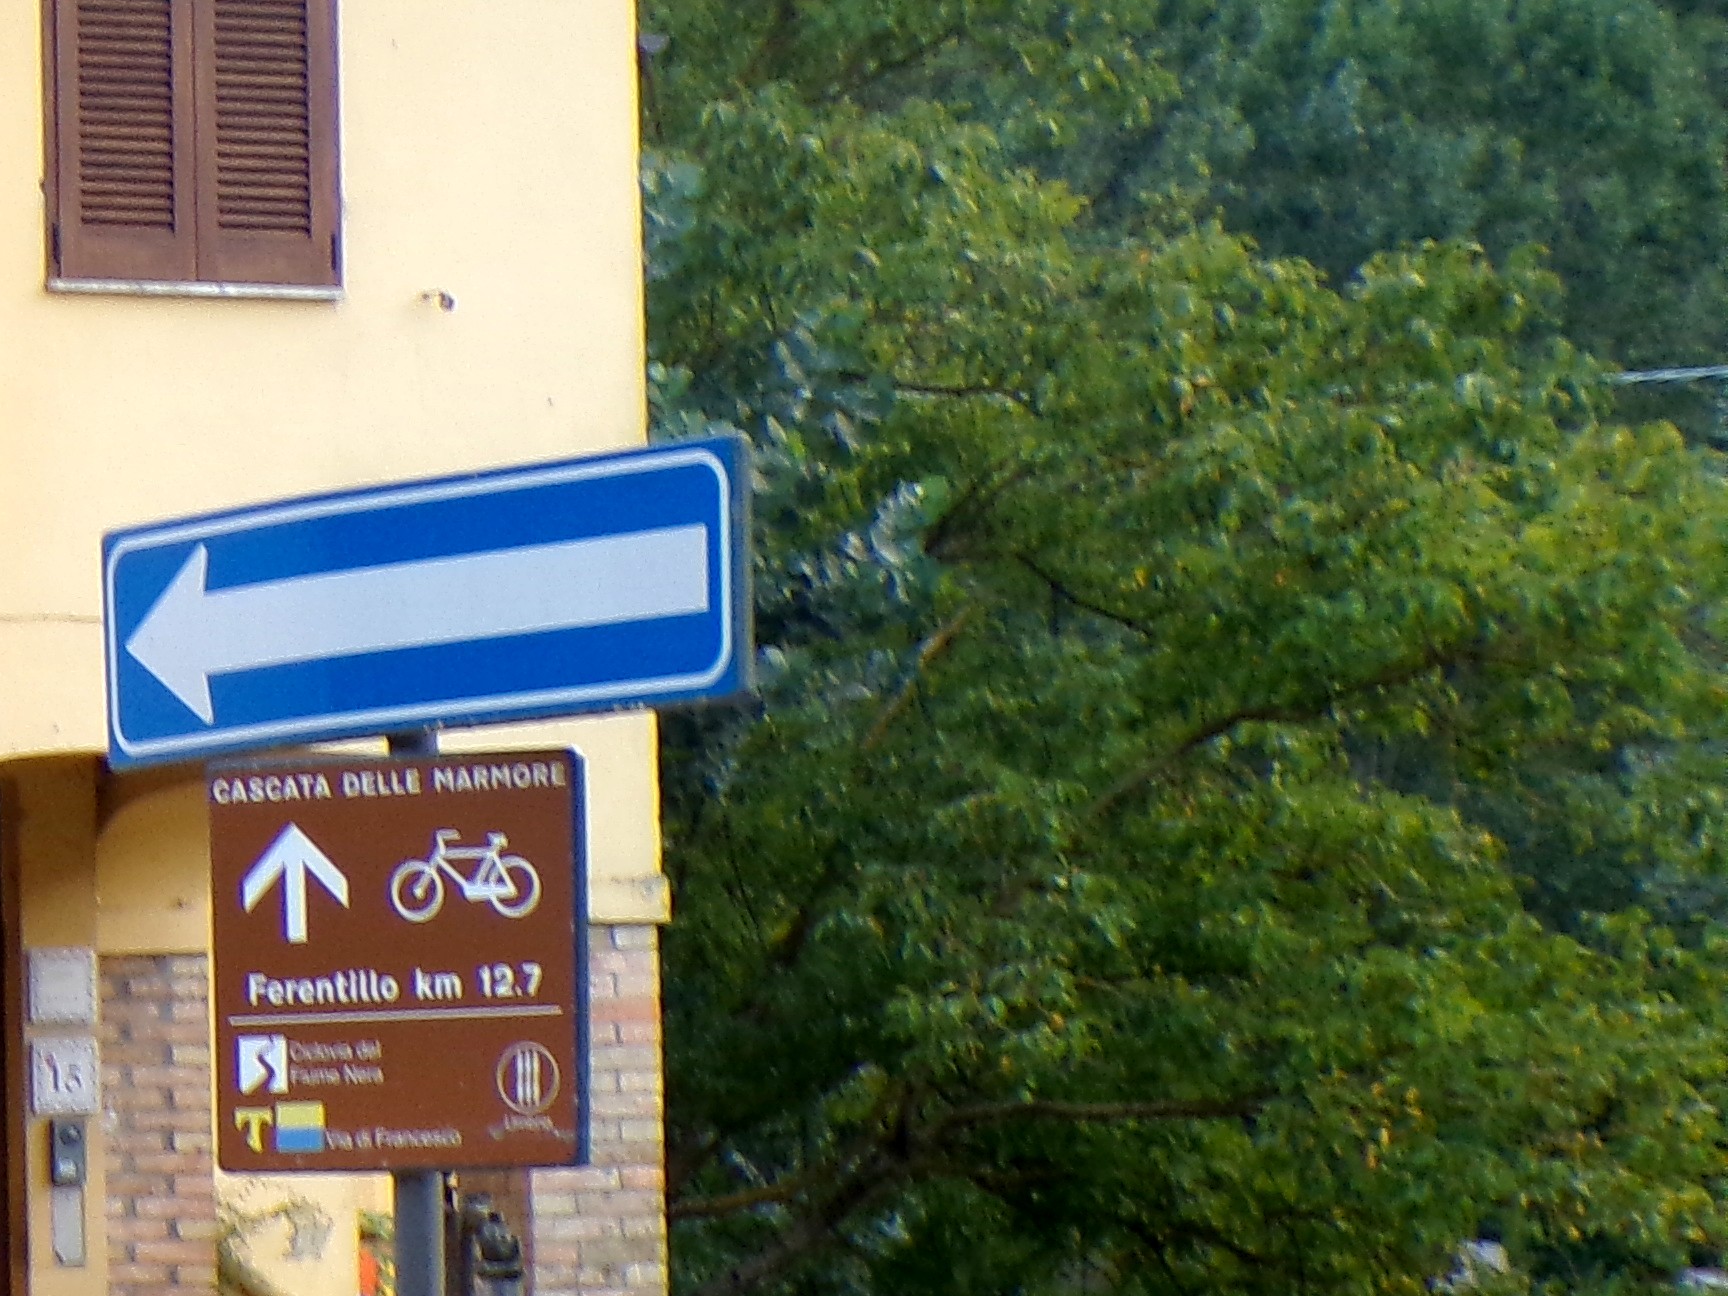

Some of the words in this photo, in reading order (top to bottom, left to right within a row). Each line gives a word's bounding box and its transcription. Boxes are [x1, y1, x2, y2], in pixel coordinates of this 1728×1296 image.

[211, 772, 333, 804] CASCATA
[342, 767, 421, 800] DELLE
[434, 760, 566, 794] MARMORE
[246, 966, 401, 1006] Ferentillo
[412, 965, 464, 1002] km
[478, 960, 543, 999] 12.7
